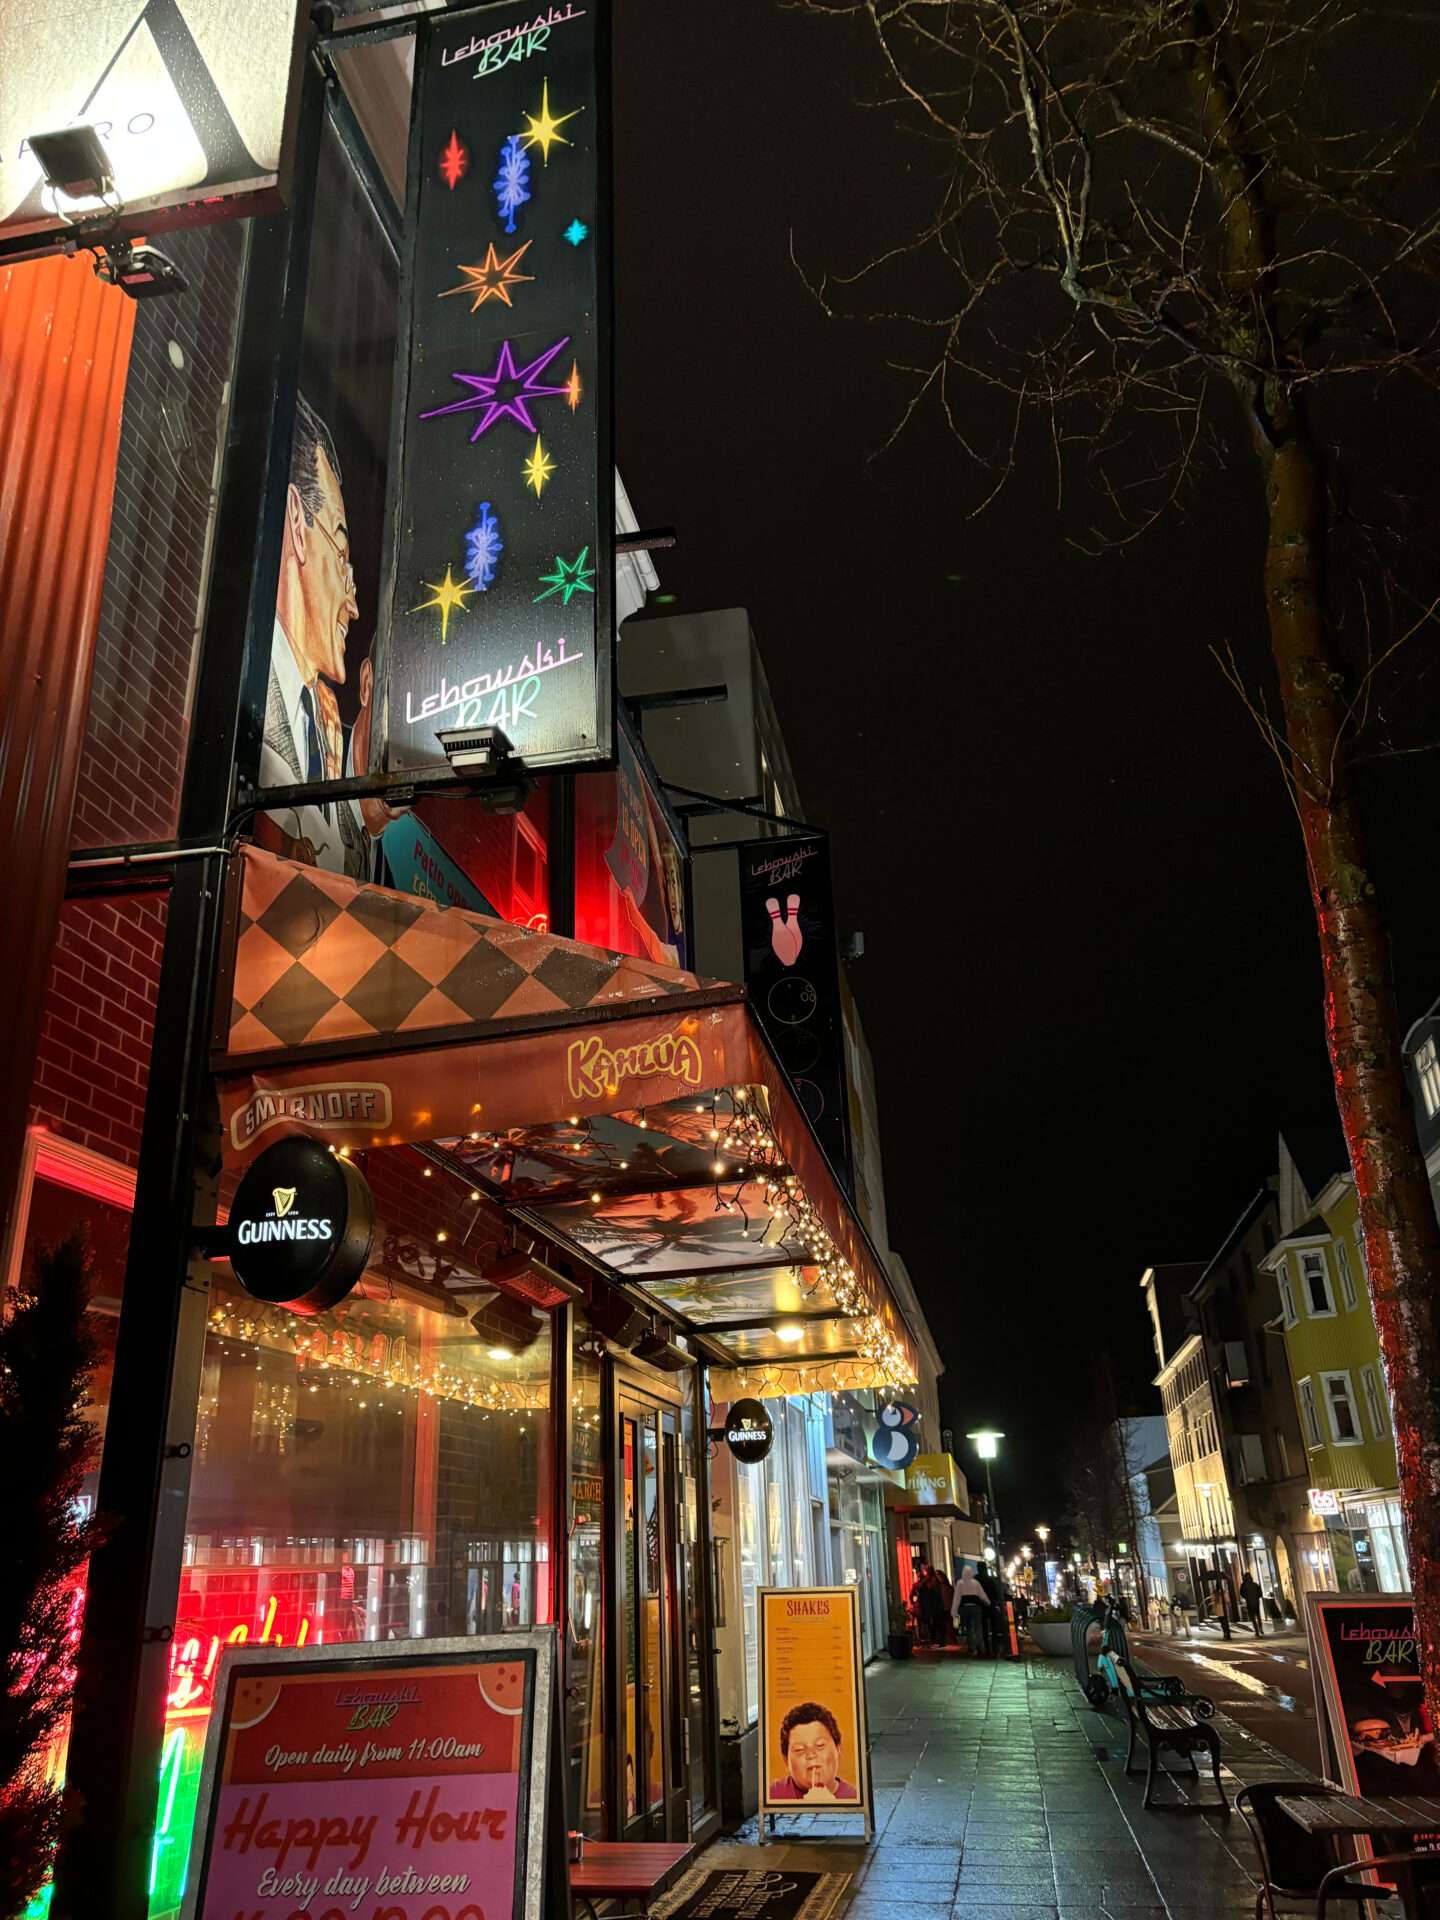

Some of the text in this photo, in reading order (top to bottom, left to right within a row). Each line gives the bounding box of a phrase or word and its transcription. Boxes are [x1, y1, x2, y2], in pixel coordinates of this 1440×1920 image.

[441, 4, 587, 67] Lebowski
[472, 26, 551, 80] BAR
[406, 637, 584, 724] Lebowski
[767, 860, 803, 887] BAR
[244, 1091, 376, 1137] SMIRNOFF
[237, 1218, 333, 1245] GUINNESS
[728, 1430, 767, 1442] GUINNESS
[786, 1599, 831, 1617] SHAKES
[1362, 1639, 1415, 1665] BAR
[345, 1702, 400, 1732] BAR
[264, 1736, 484, 1774] Open daily from 11:00am
[222, 1792, 378, 1873] Happy
[395, 1785, 508, 1849] Hour
[257, 1865, 471, 1911] Every day between
